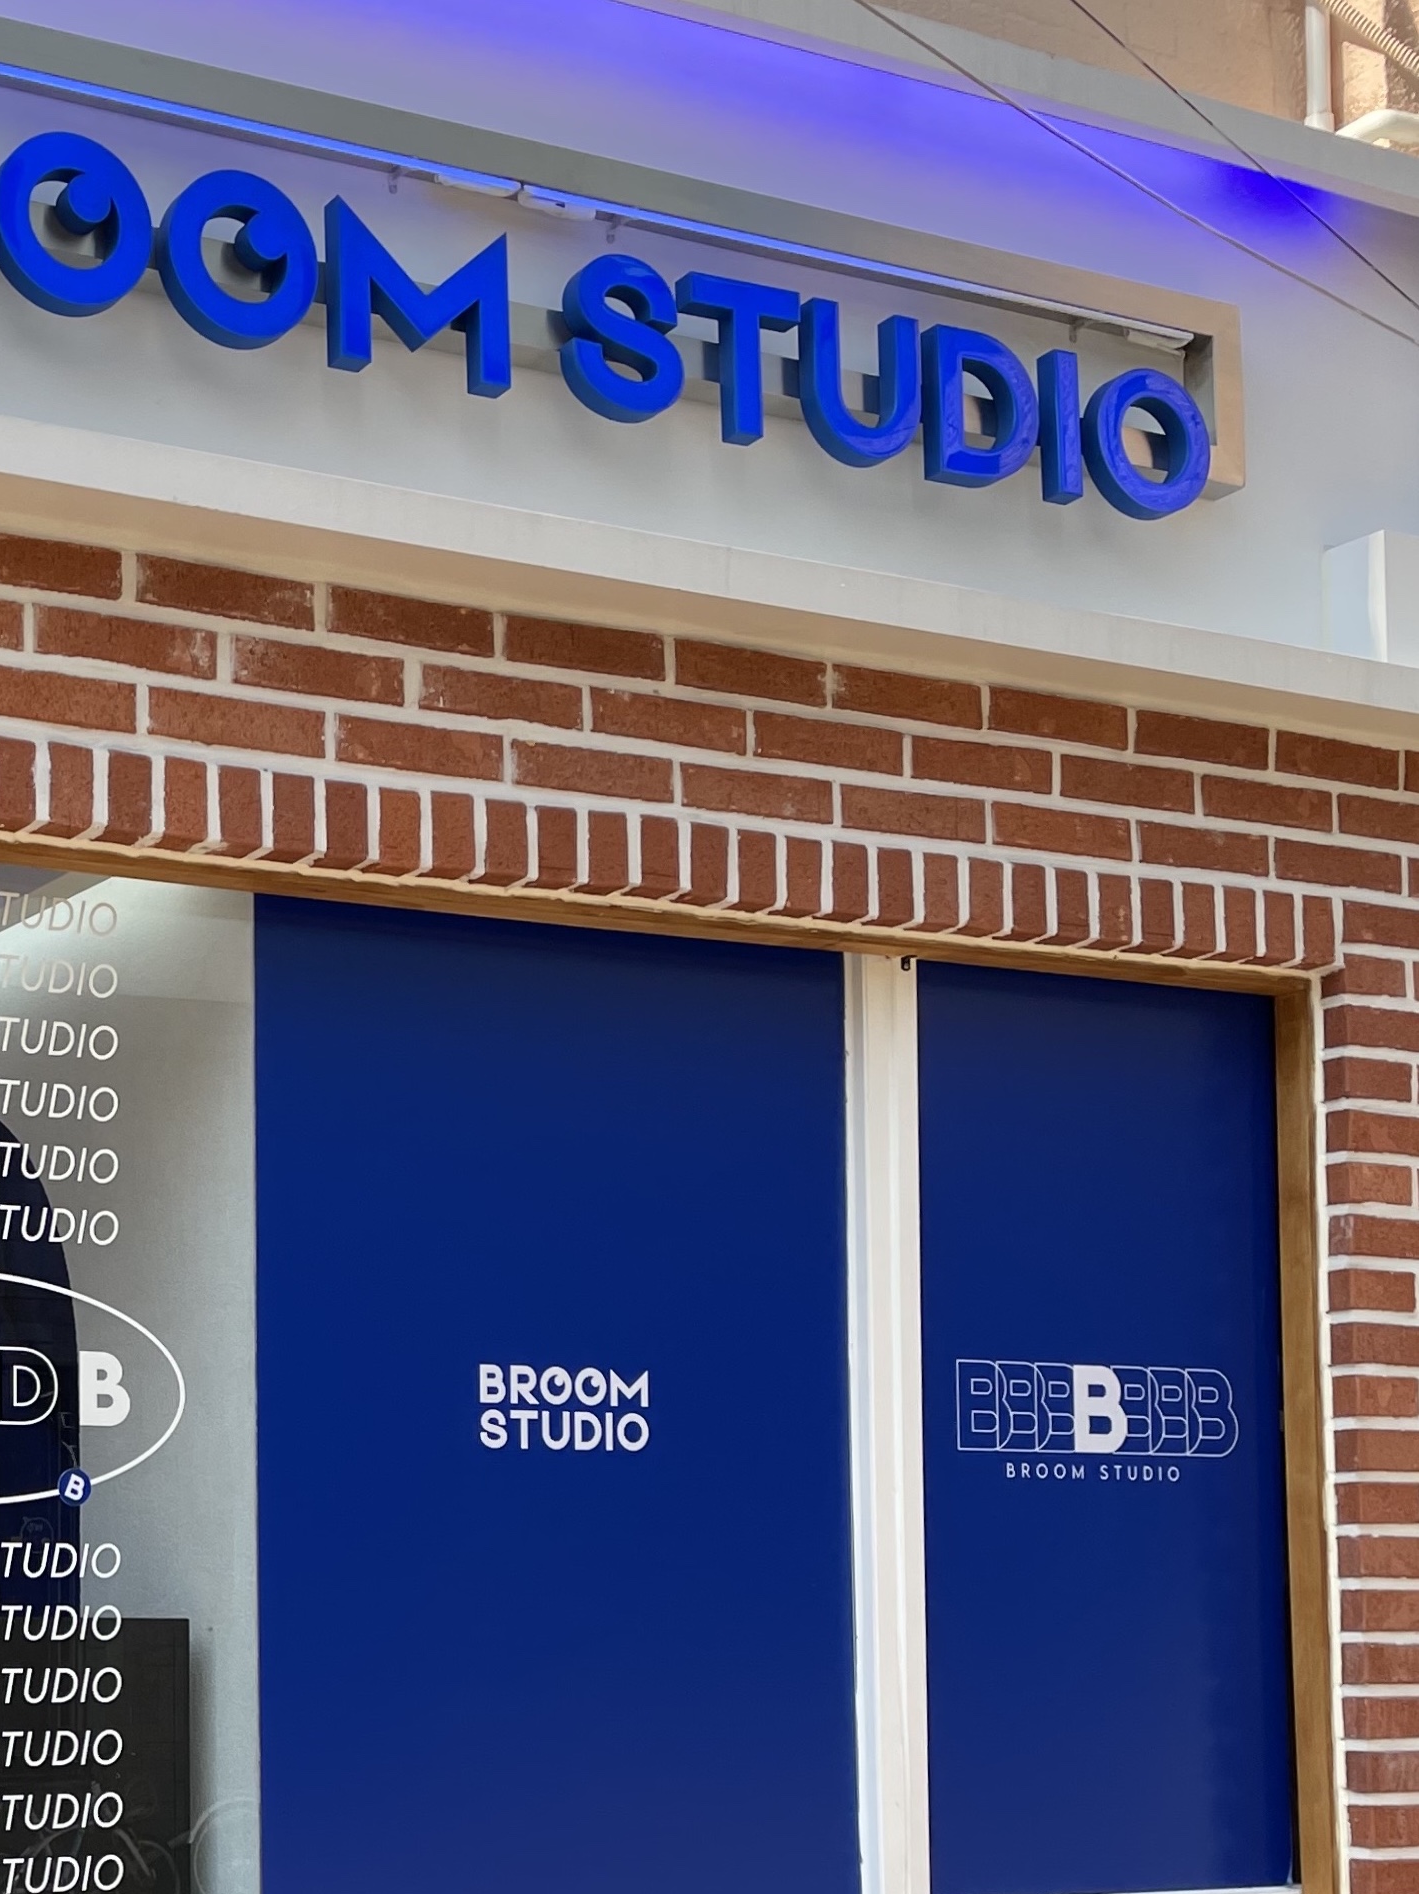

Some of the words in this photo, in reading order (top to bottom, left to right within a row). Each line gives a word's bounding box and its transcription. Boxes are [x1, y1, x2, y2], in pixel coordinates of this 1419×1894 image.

[561, 253, 1212, 523] STUDIO
[78, 1350, 131, 1427] B
[479, 1363, 649, 1408] BROOM
[479, 1409, 649, 1452] STUDIO
[63, 1472, 86, 1502] B
[1006, 1462, 1085, 1480] BROOM
[1100, 1464, 1180, 1482] STUDIO
